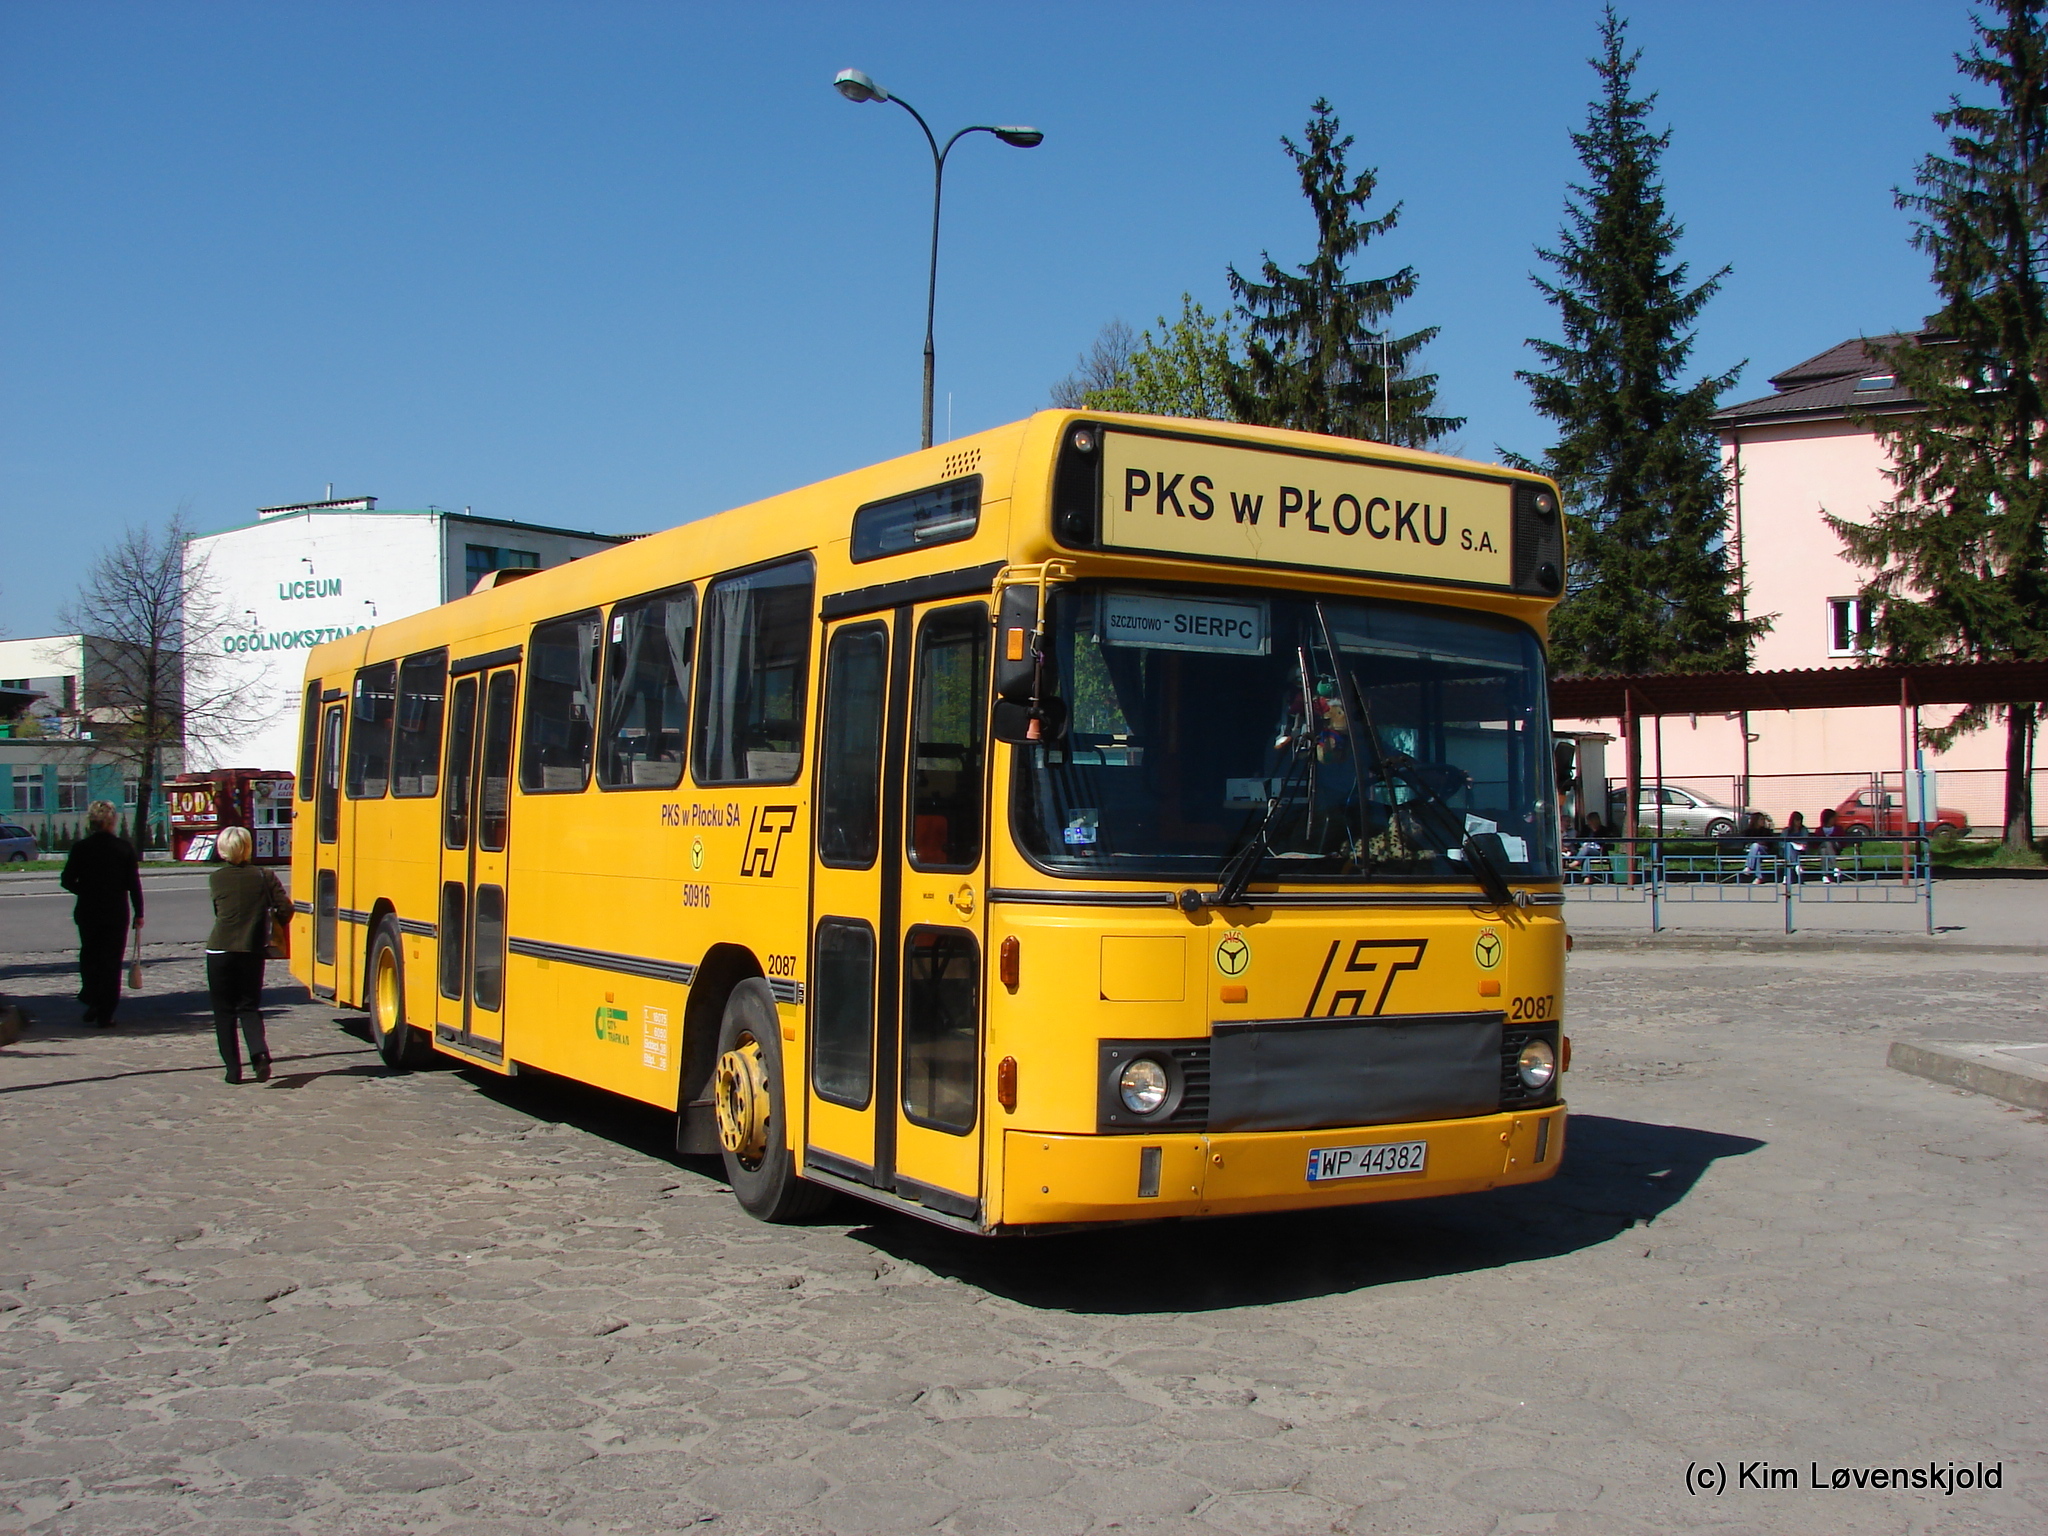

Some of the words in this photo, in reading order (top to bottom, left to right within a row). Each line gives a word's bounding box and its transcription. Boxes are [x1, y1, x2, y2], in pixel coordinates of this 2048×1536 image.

[1125, 468, 1214, 521] PKS
[1230, 491, 1263, 525] w
[1279, 485, 1448, 546] PŁOCKU
[1460, 528, 1498, 554] S.A.
[279, 578, 342, 600] LICEUM
[1110, 614, 1162, 631] SZCZUTOWO
[1174, 613, 1252, 639] SIERPC
[223, 625, 375, 653] OGÓLNOKSZTAŁ
[172, 789, 216, 813] LODY
[661, 803, 680, 826] PKS
[682, 809, 690, 826] w
[692, 803, 724, 827] Płocku
[726, 803, 741, 827] SA
[683, 884, 711, 908] 50916
[768, 954, 797, 976] 2087
[1511, 994, 1554, 1020] 2087
[1322, 1150, 1352, 1176] WP
[1360, 1145, 1422, 1173] 44382
